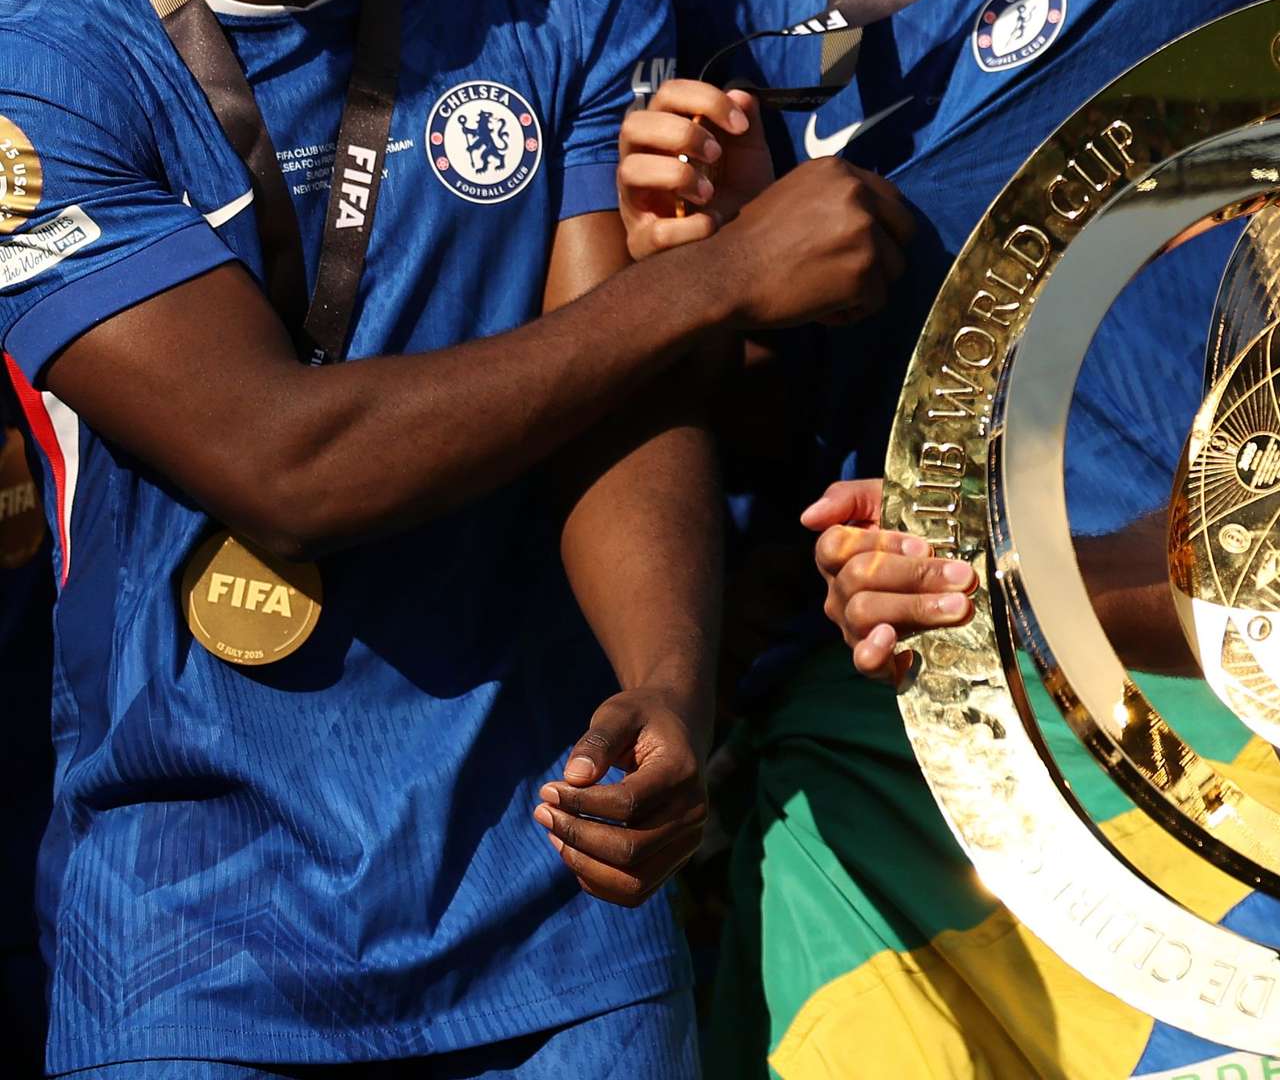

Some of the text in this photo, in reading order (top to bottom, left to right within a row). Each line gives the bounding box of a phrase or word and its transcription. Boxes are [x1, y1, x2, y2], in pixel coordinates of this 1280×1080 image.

[439, 85, 511, 118] CHELSEA
[276, 149, 295, 161] FIFA
[294, 144, 319, 158] CLUB
[386, 139, 414, 154] RMAIN
[13, 163, 28, 196] USA
[336, 145, 377, 229] FIFA
[456, 166, 529, 197] FOOTBALL CLUB
[56, 229, 84, 251] FIFA
[912, 119, 1136, 560] LUB WORLD CUP
[311, 348, 325, 367] FI
[207, 572, 293, 618] FIFA
